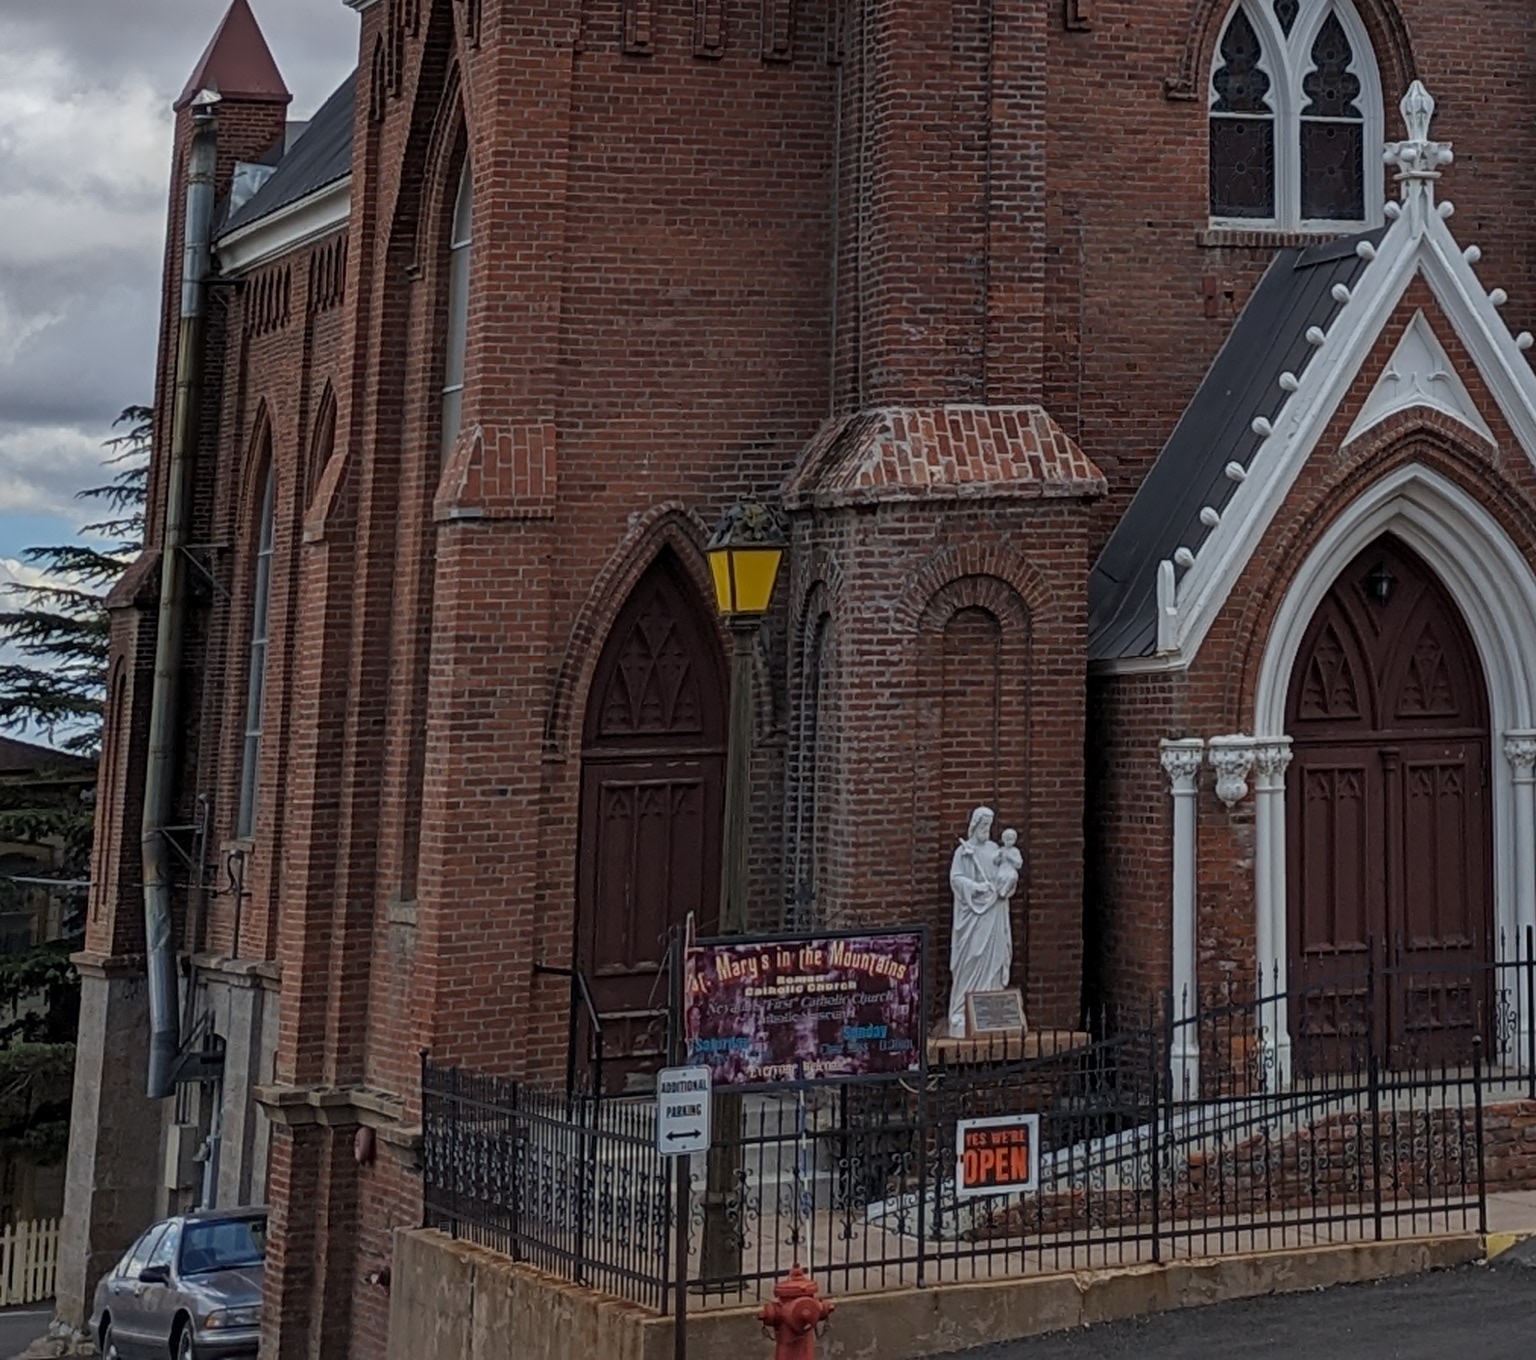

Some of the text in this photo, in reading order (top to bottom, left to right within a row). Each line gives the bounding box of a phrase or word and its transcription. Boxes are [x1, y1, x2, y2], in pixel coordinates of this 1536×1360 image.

[776, 945, 791, 968] in
[799, 943, 822, 971] the
[828, 940, 906, 980] Mountains
[745, 980, 857, 997] Catholic Church
[843, 1022, 888, 1040] Sunday
[661, 1079, 709, 1093] ADDITIONAL
[666, 1103, 702, 1119] PARKING
[966, 1129, 1026, 1146] YES WE'RE
[964, 1146, 1027, 1185] OPEN
